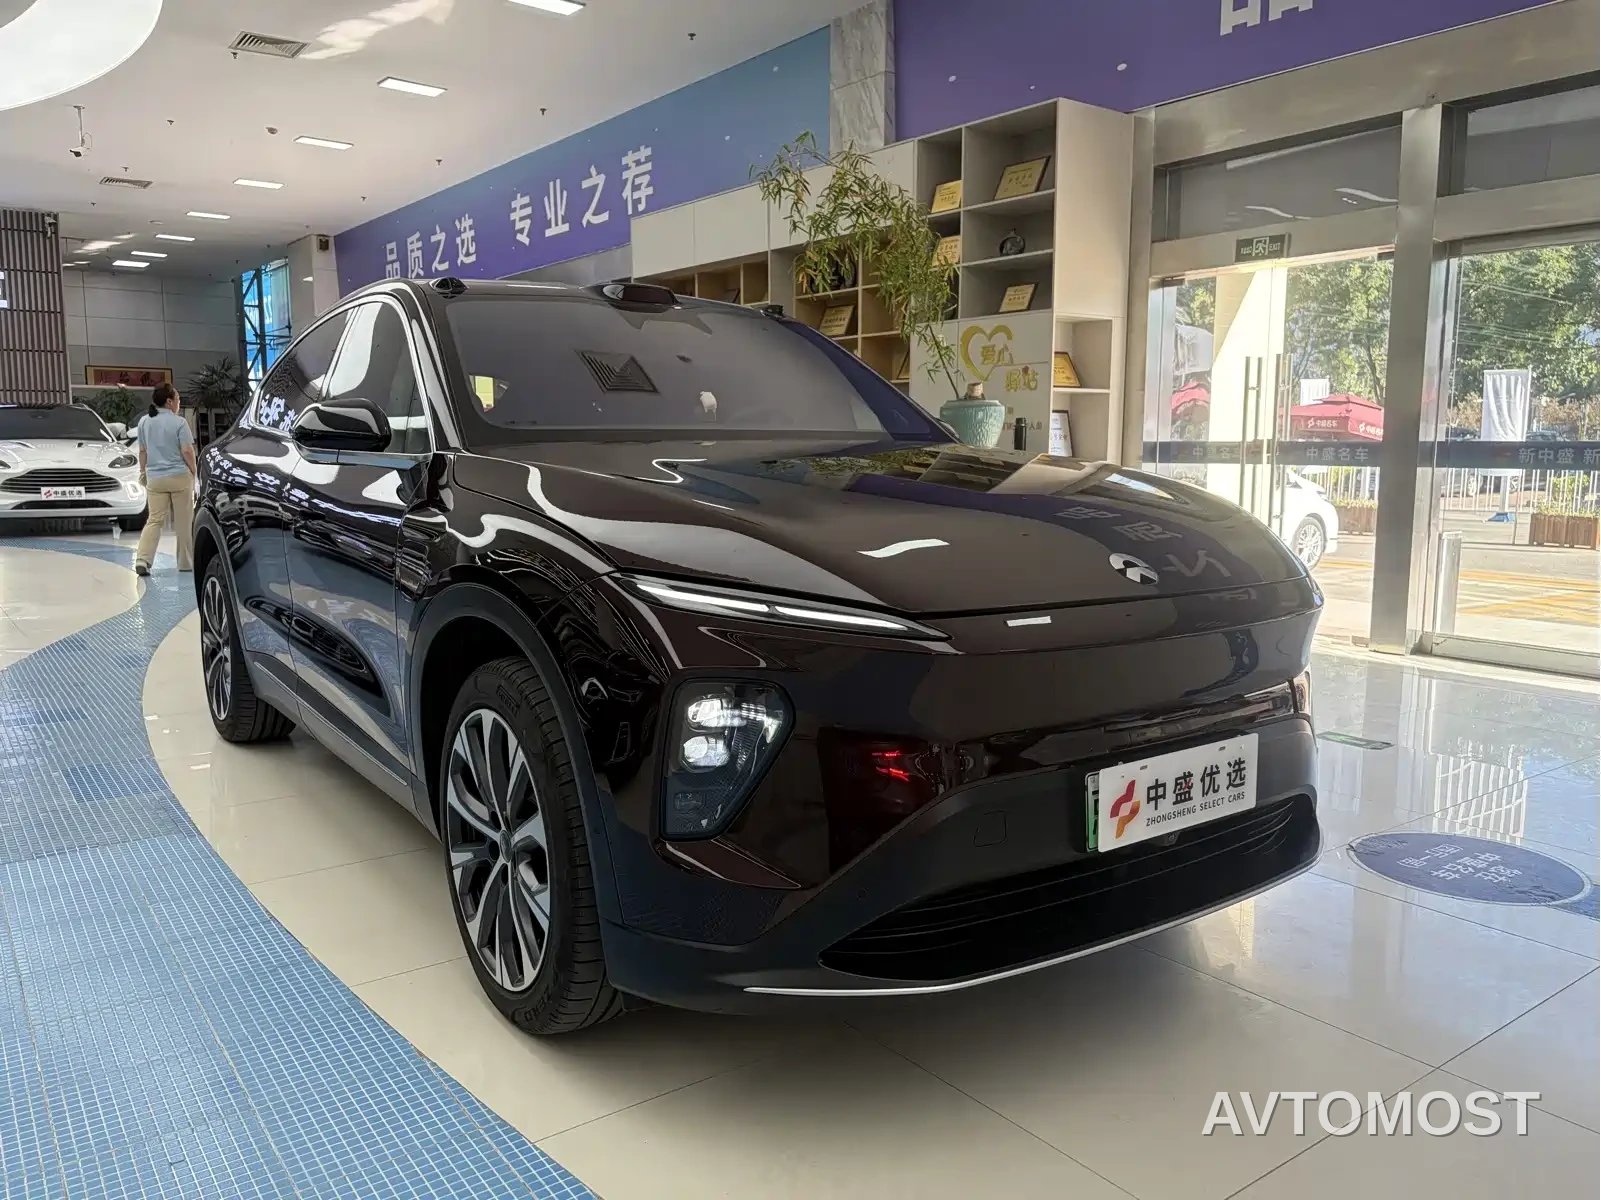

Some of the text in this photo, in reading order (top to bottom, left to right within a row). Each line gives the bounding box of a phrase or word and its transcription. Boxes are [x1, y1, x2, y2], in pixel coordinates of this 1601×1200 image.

[385, 145, 653, 279] 品质之选 专业之荐
[1268, 242, 1281, 252] EXIT
[980, 343, 1014, 366] 爱心
[1307, 446, 1369, 463] 中盛名车
[1518, 447, 1575, 465] 新中盛
[1146, 757, 1246, 811] 中盛优选
[1146, 791, 1246, 827] ZHONGSHENG SELECT CARS
[1430, 852, 1502, 880] 中盛名车
